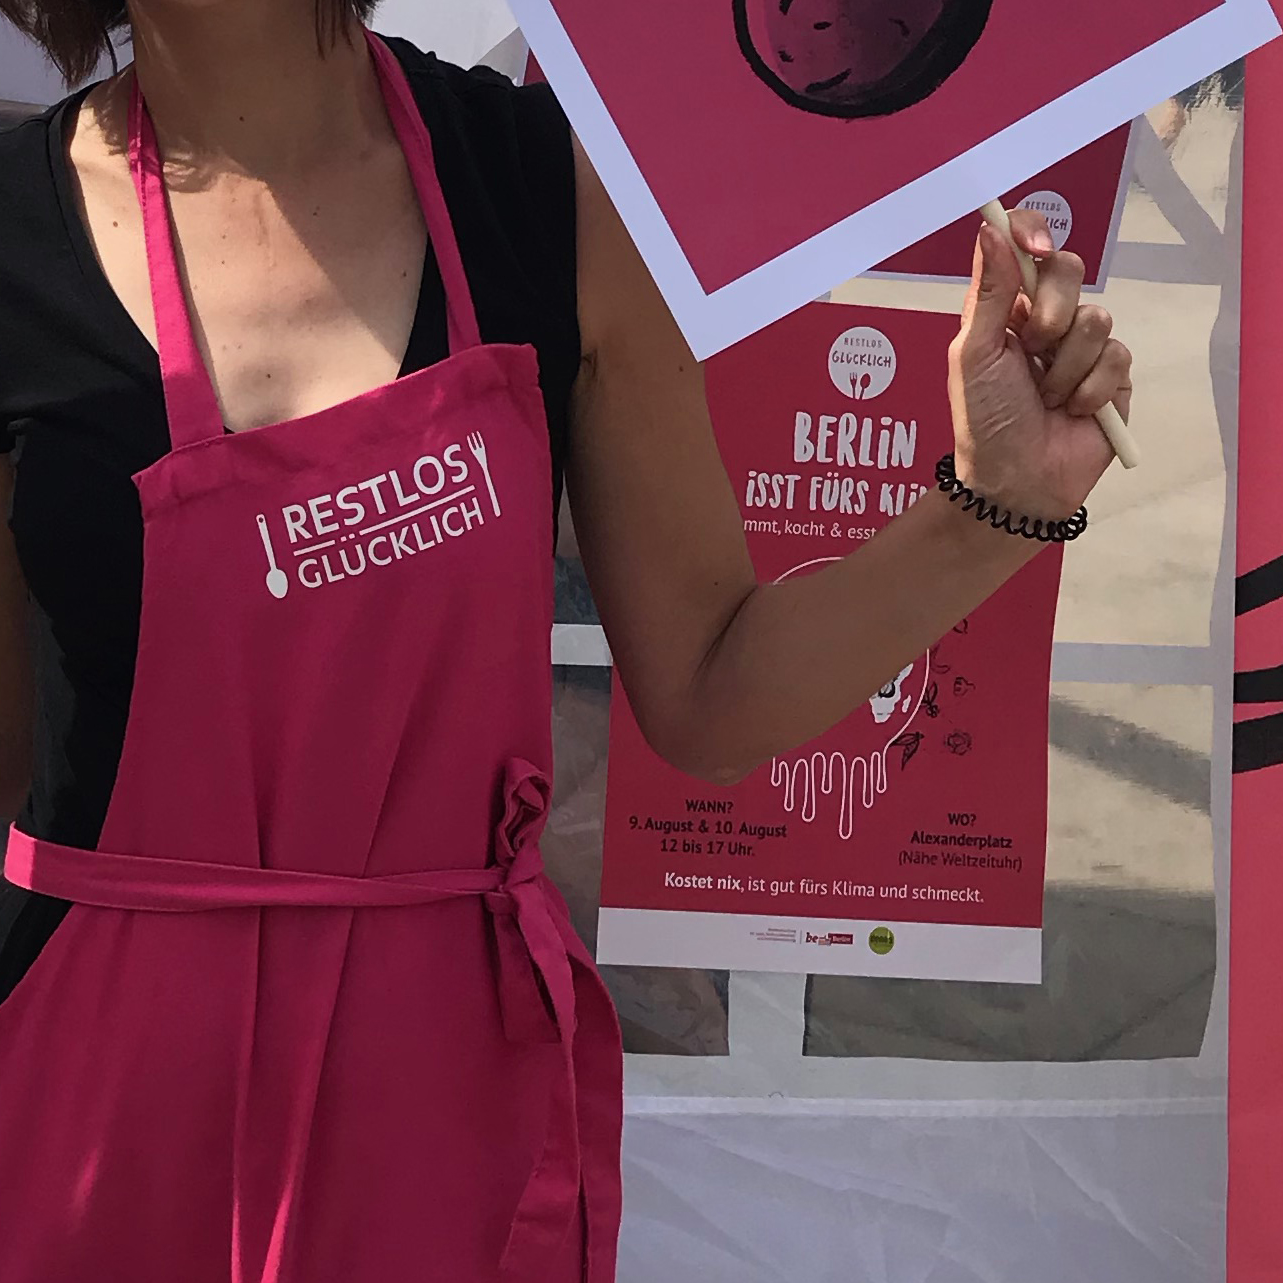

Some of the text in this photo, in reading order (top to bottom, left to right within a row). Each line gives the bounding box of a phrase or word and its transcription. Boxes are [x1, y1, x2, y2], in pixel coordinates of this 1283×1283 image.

[843, 337, 883, 349] RESTLOS
[282, 444, 469, 544] RESTLOS
[809, 472, 870, 515] FÜRS
[743, 519, 782, 537] mmt,
[784, 519, 825, 537] kocht
[830, 522, 842, 538] &
[297, 496, 485, 589] GLÜCKLICH
[685, 799, 734, 814] WANN?
[644, 817, 694, 835] August
[698, 820, 709, 833] &
[738, 822, 787, 839] August
[948, 813, 977, 827] WO?
[660, 838, 755, 857] 12 bis 17 Uhr.
[911, 831, 1013, 850] Alexanderplatz
[941, 852, 1023, 871] Weltzeituhr)
[664, 871, 984, 904] Kostet nix, ist gut fürs Klima und schmeckt.
